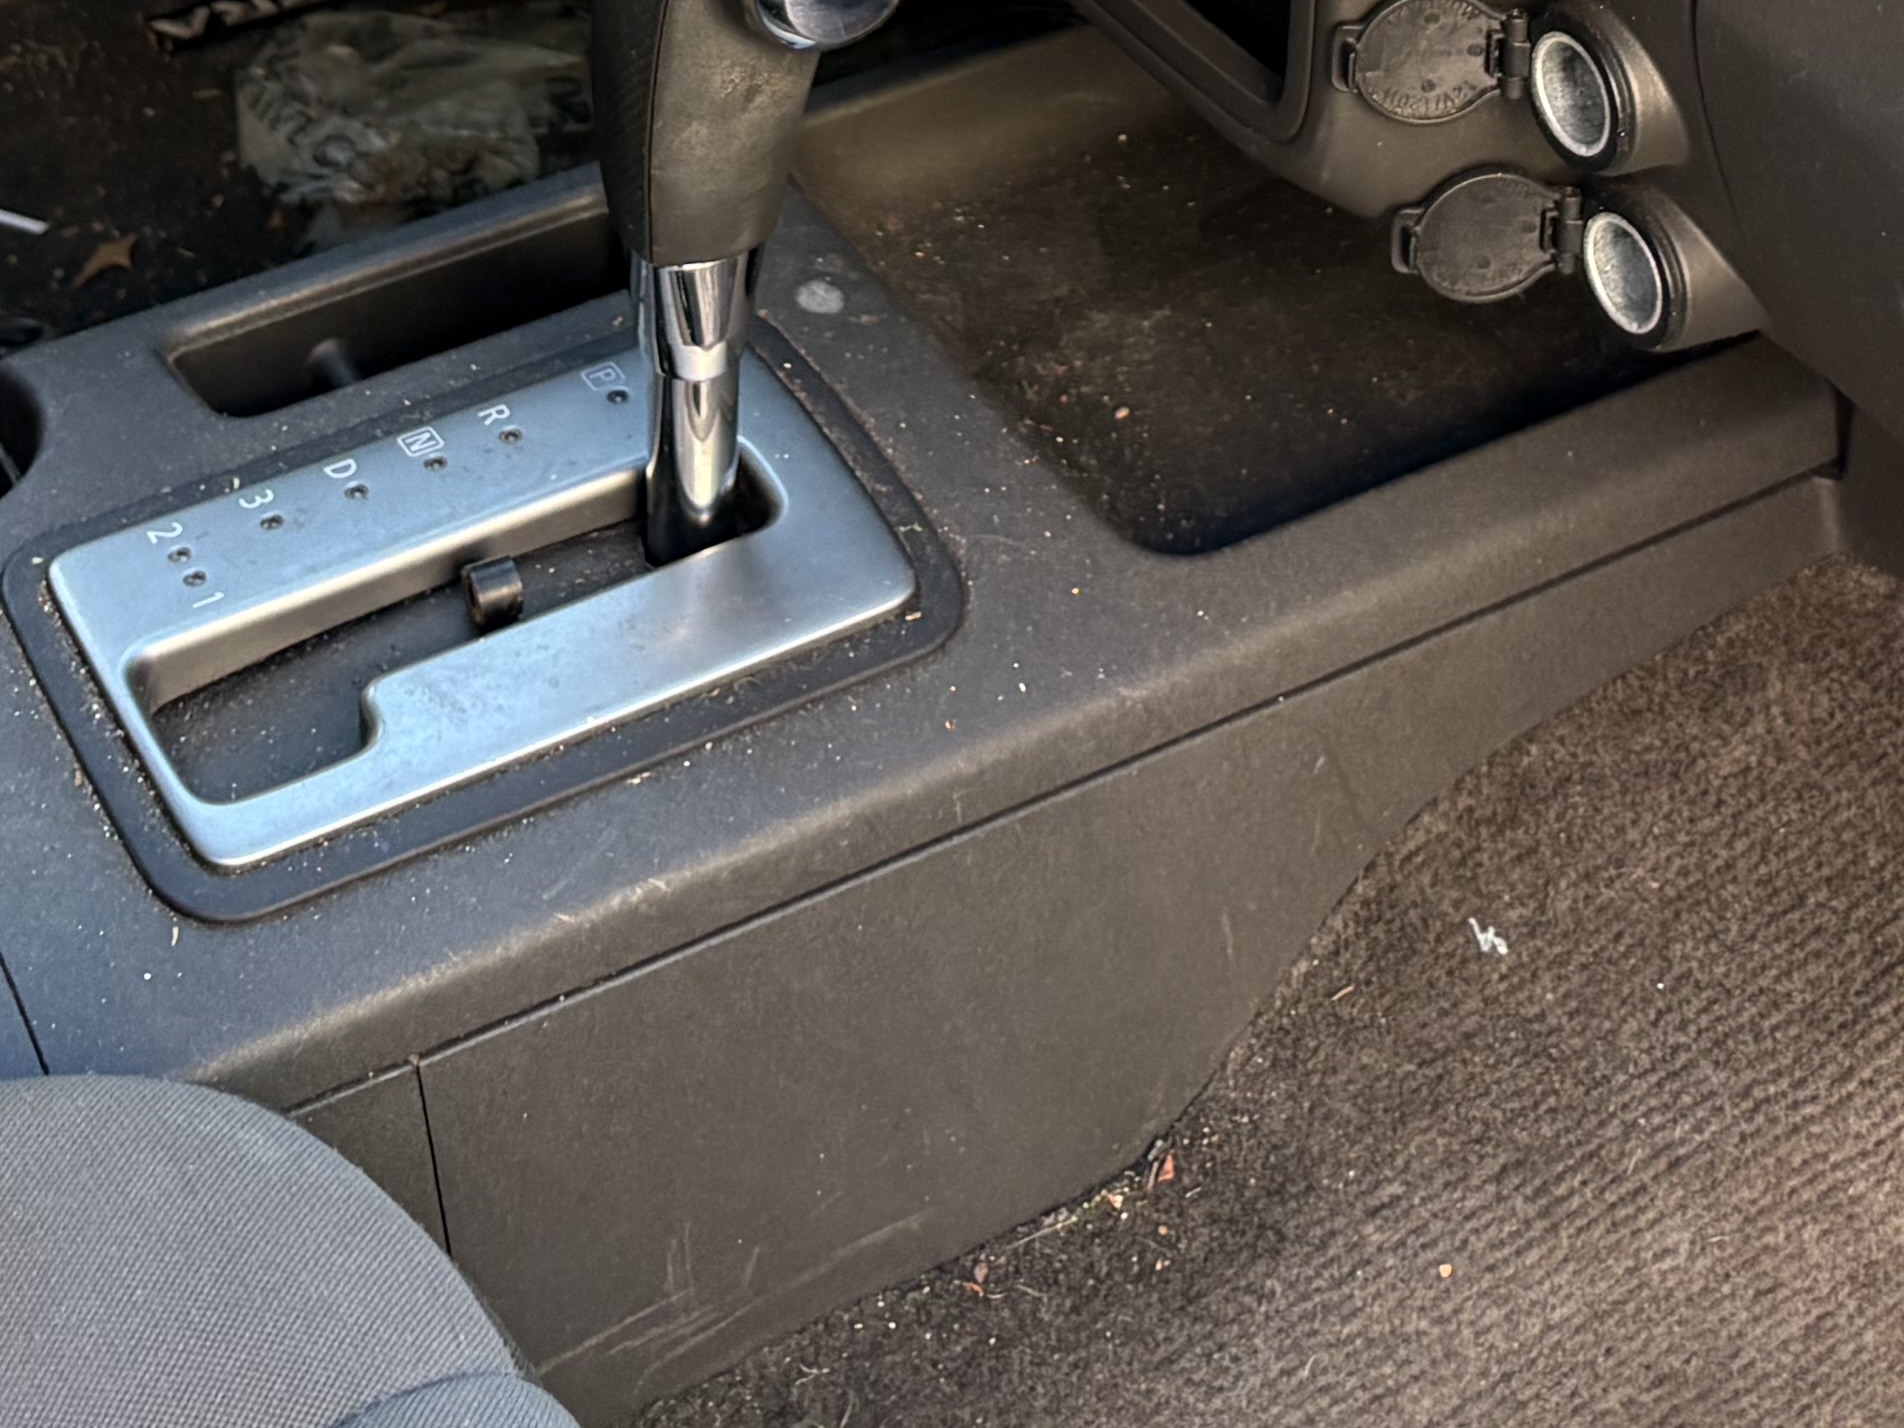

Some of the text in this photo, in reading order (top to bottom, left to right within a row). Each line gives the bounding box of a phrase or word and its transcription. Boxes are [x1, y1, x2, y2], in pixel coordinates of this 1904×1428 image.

[589, 368, 617, 383] P
[478, 404, 511, 426] R
[405, 431, 437, 453] N
[323, 458, 358, 479] D
[238, 489, 274, 509] 3
[146, 522, 184, 545] 2
[192, 591, 225, 609] 1
